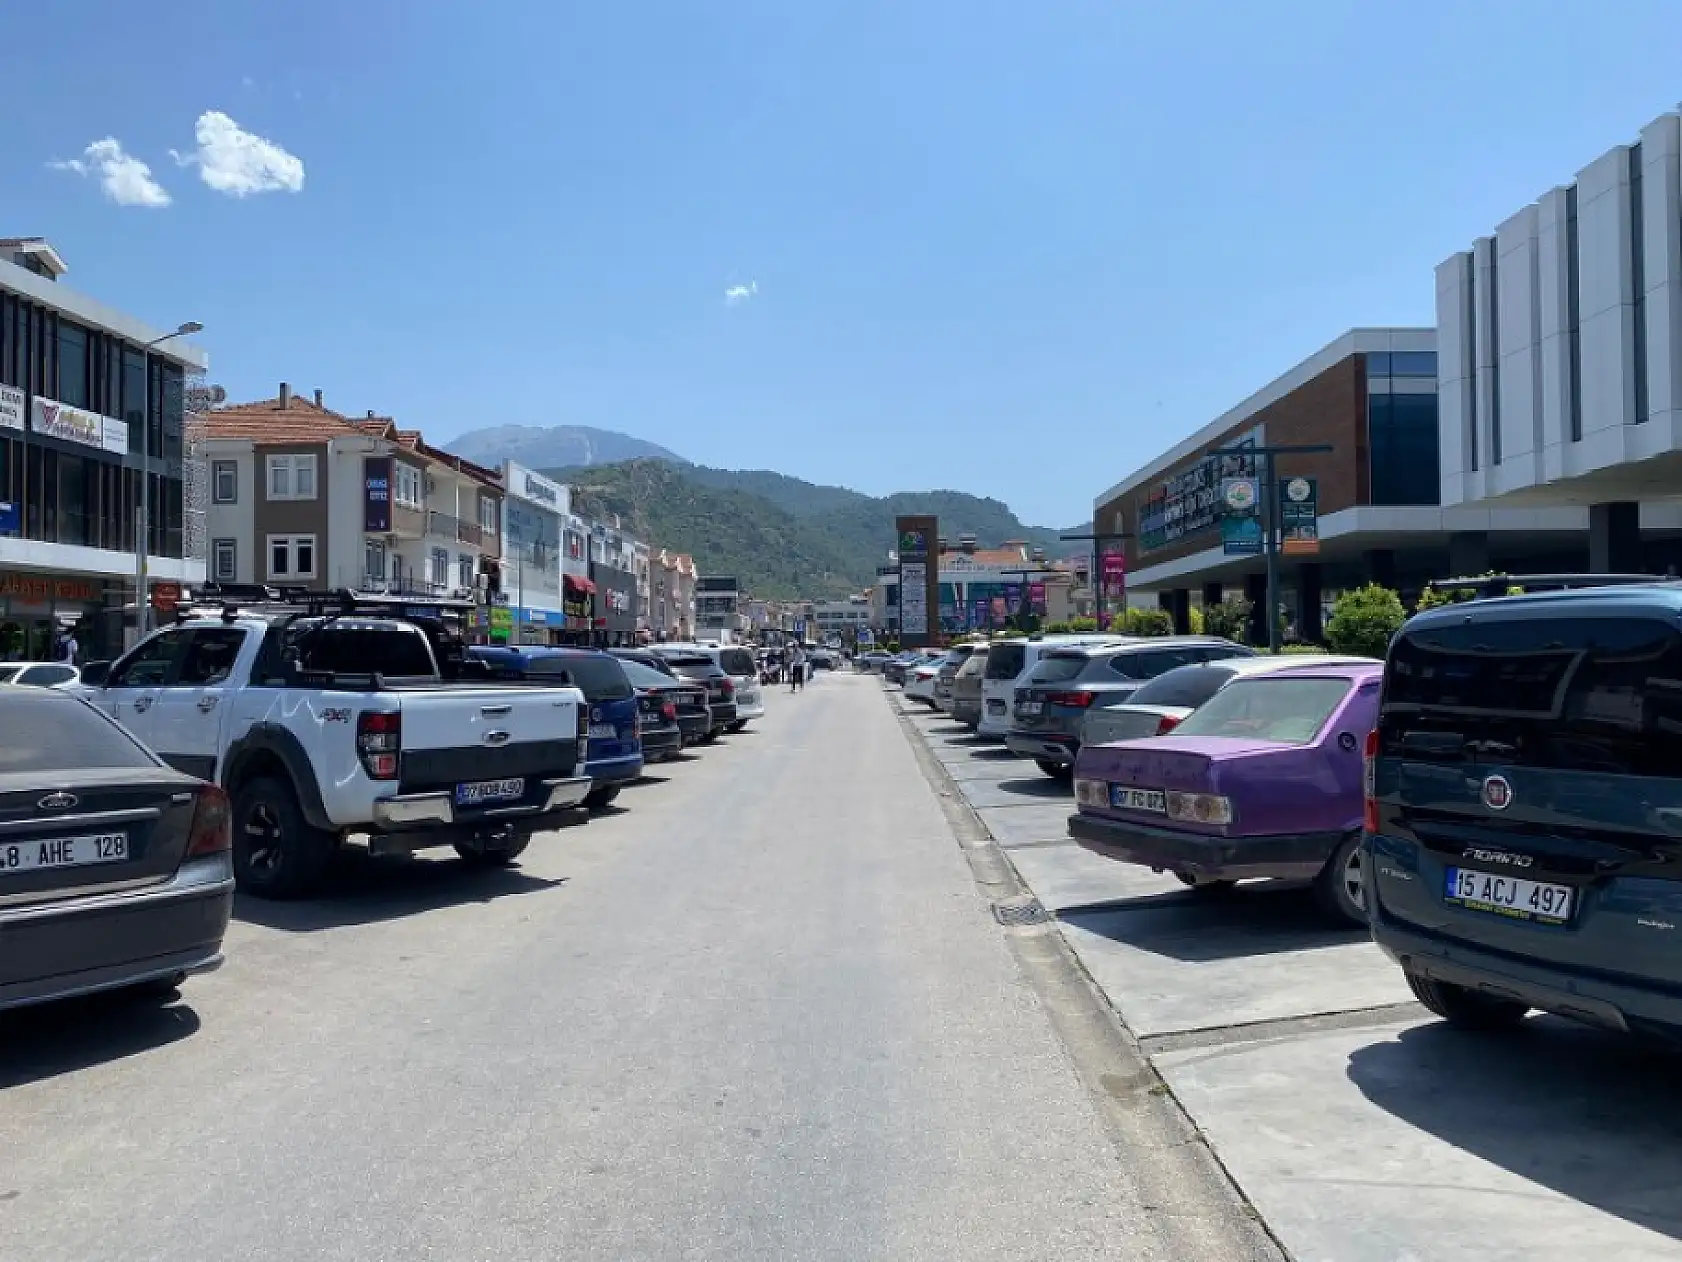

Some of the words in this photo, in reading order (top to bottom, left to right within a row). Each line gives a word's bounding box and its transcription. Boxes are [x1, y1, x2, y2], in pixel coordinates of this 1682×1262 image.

[39, 840, 74, 865] AHE
[94, 835, 124, 859] 128
[1458, 871, 1476, 897] 15
[1482, 877, 1518, 906] ACJ
[1528, 884, 1567, 914] 497
